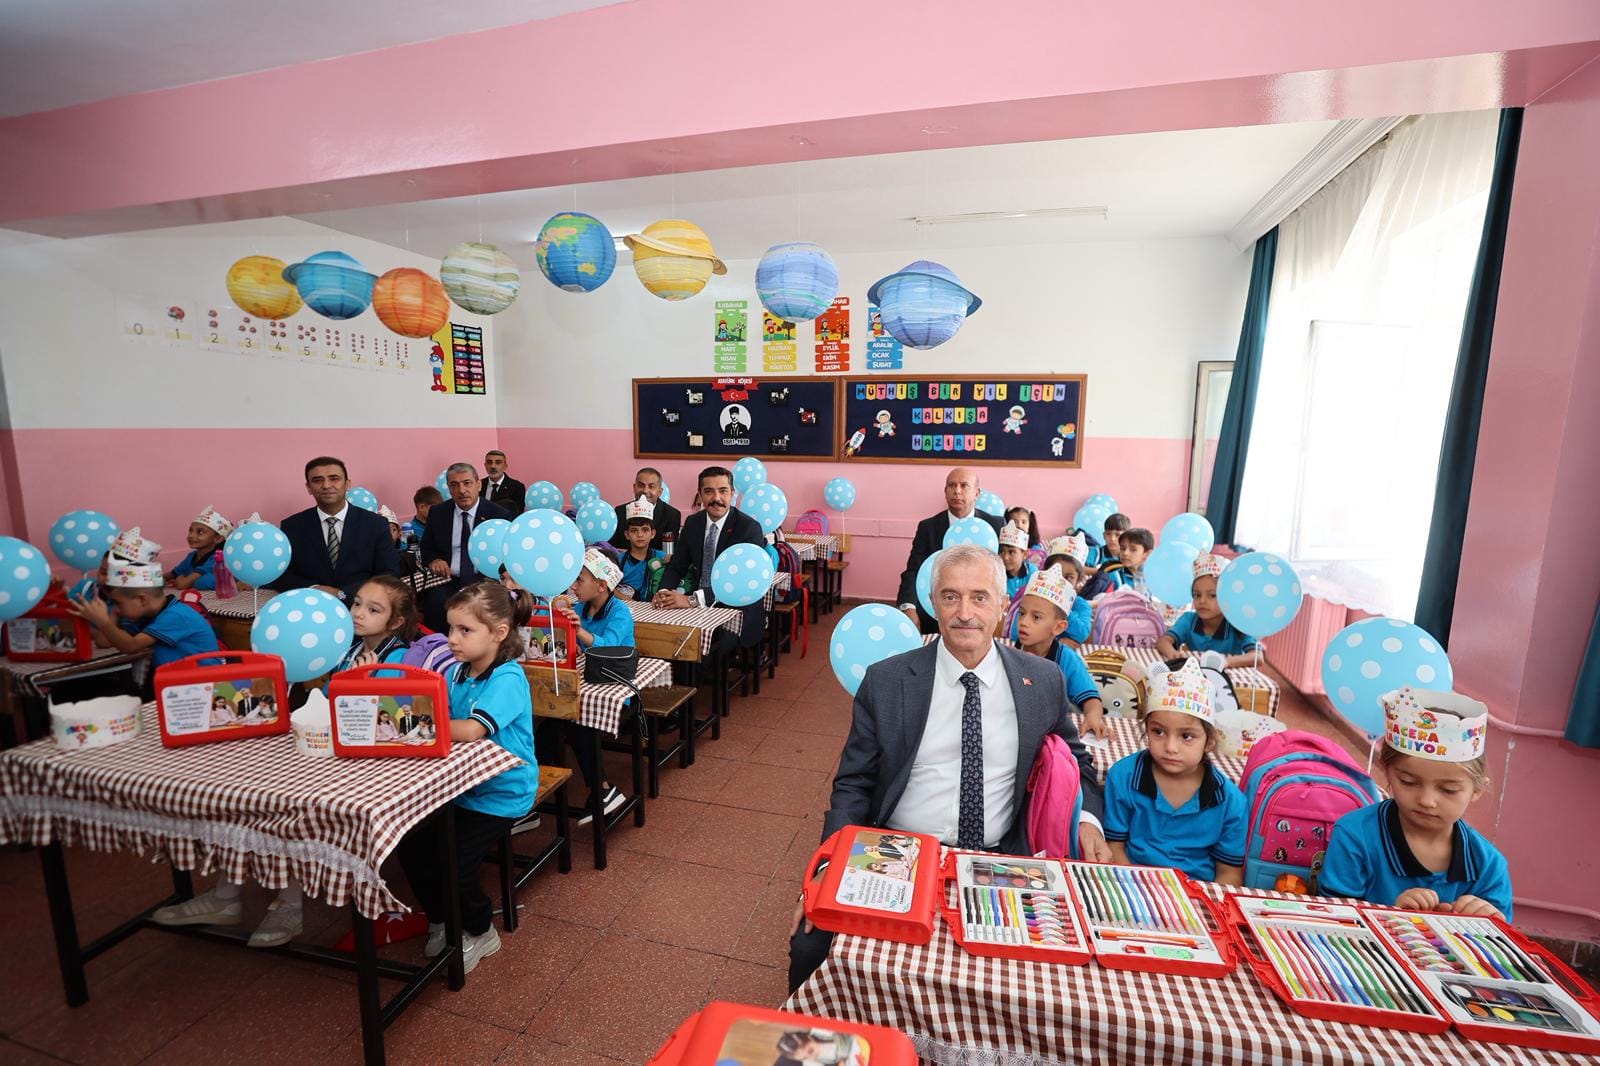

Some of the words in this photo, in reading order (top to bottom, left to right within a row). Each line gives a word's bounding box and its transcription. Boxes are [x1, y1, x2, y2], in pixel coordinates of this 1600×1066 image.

[133, 322, 143, 335] 0
[175, 328, 180, 339] 1
[211, 332, 219, 344] 2
[244, 337, 252, 348] 3
[275, 341, 282, 351] 4
[304, 346, 311, 356] 5
[331, 350, 337, 359] 6
[356, 353, 361, 362] 7
[379, 358, 384, 366] 8
[400, 361, 405, 369] 9
[857, 385, 917, 398] MÜTHİŞ
[930, 385, 959, 396] BİR
[976, 386, 1004, 397] YIL
[1023, 384, 1064, 399] İÇİN
[914, 411, 986, 423] KALKIŞA
[914, 438, 983, 448] HAZIRIZ
[1168, 688, 1209, 706] MACERA
[1386, 731, 1447, 756] AŞLIYOR
